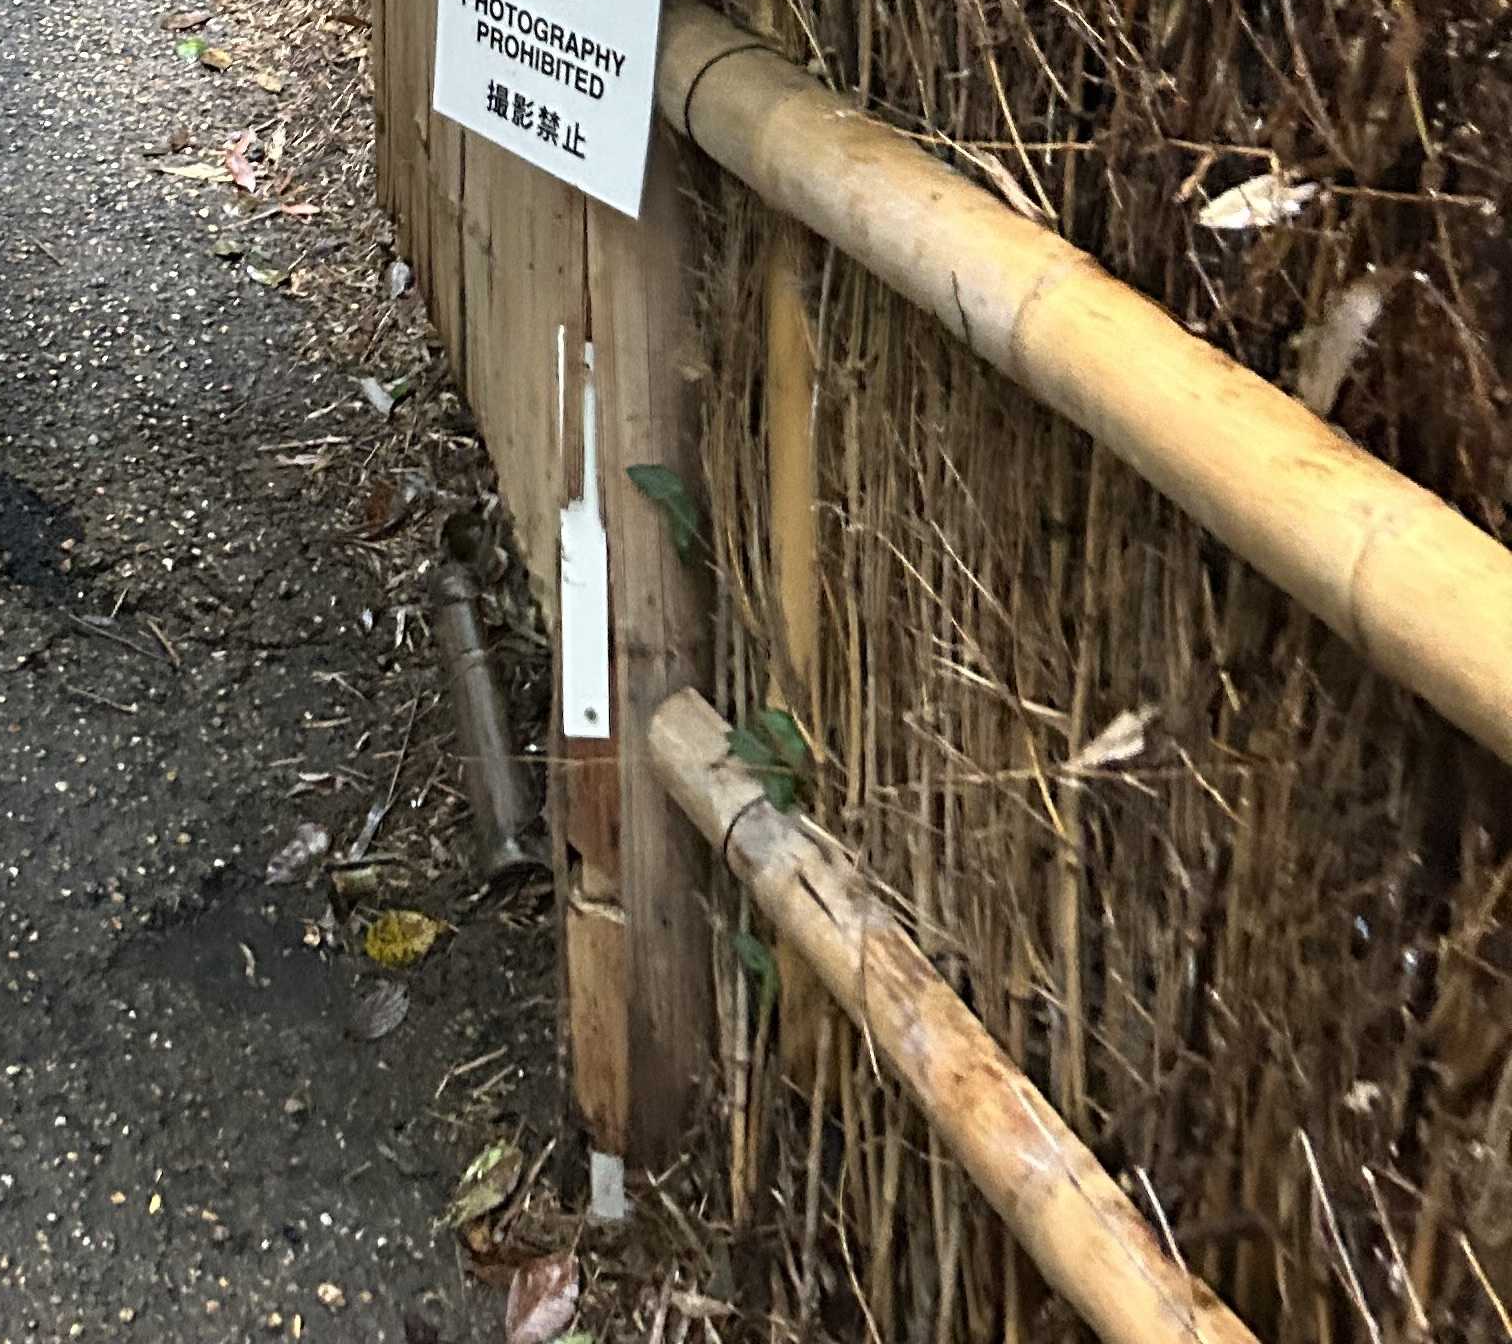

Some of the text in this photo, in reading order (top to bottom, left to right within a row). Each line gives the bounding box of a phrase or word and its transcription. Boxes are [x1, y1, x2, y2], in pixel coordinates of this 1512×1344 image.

[476, 20, 605, 101] PROHIBITED
[486, 79, 587, 160] 撮影禁止
